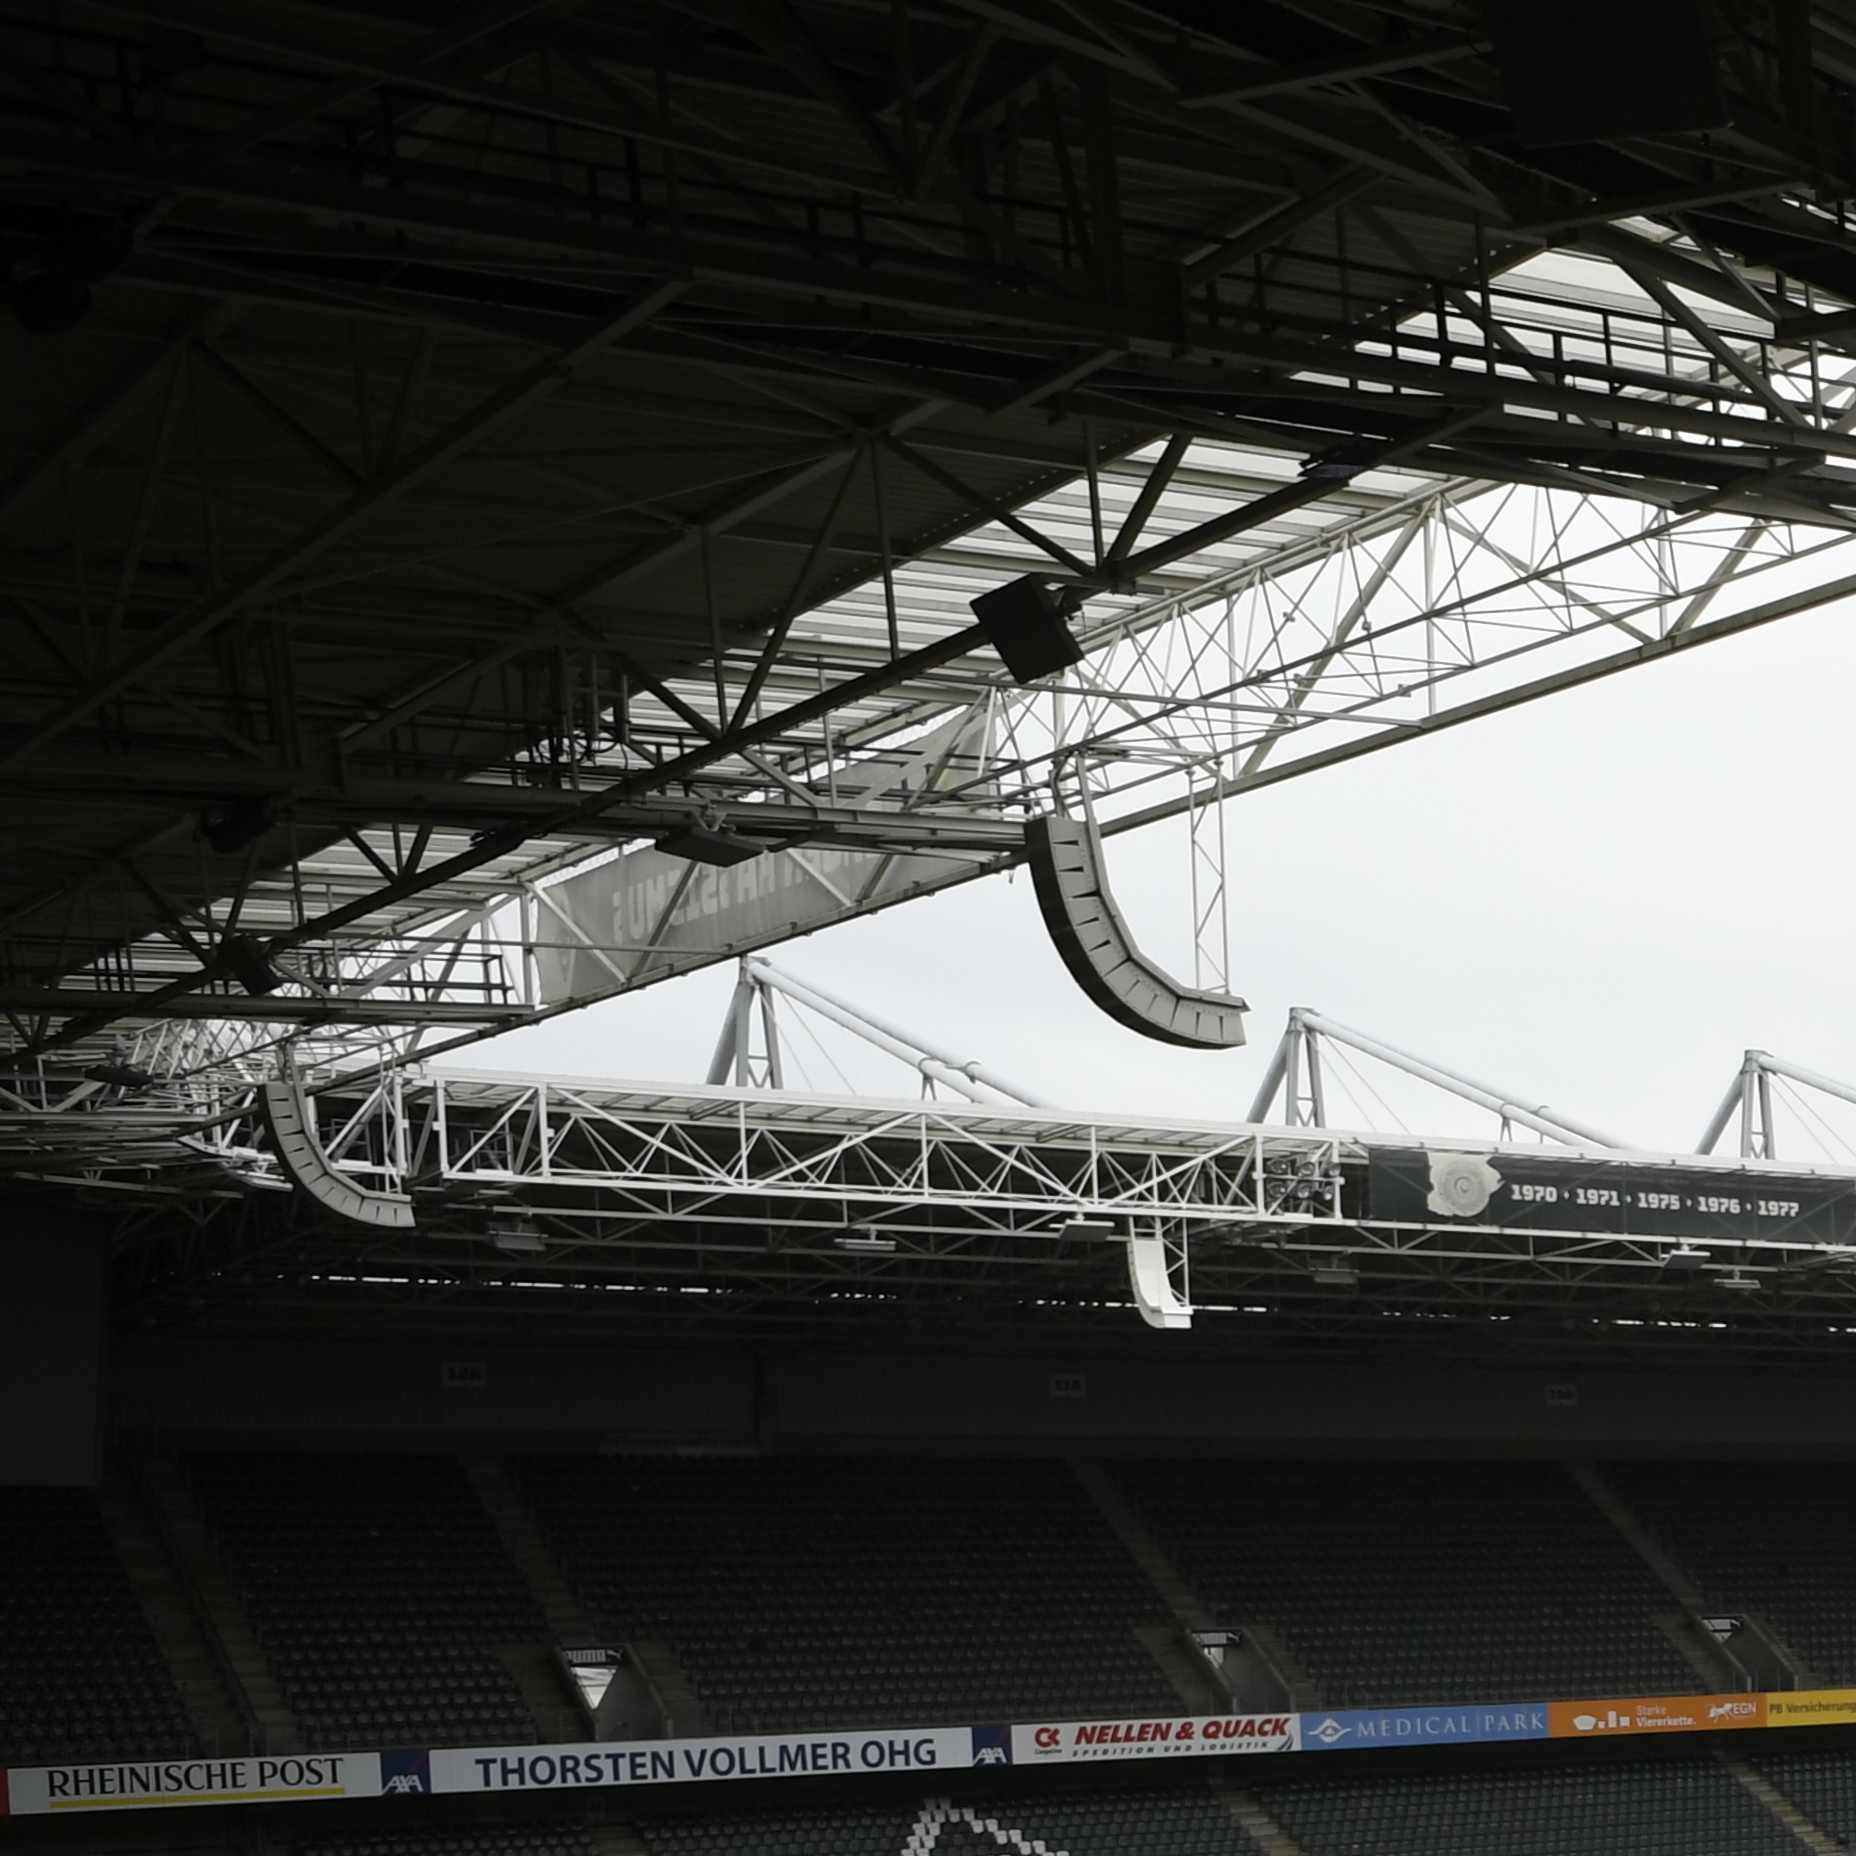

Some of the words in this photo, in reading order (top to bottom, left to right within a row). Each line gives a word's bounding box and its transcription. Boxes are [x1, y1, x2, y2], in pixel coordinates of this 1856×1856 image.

[1511, 1184, 1558, 1203] 1970
[1575, 1188, 1621, 1206] 1971
[1637, 1192, 1681, 1211] 1975
[1697, 1196, 1741, 1215] 1976
[1758, 1199, 1800, 1217] 1977
[1733, 1702, 1758, 1716] EGN
[1768, 1703, 1785, 1715] PB
[1075, 1724, 1172, 1746] NELLEN
[1176, 1721, 1196, 1740] &
[1201, 1718, 1292, 1739] QUACK
[1357, 1717, 1471, 1740] MEDICAL
[1483, 1712, 1546, 1735] PARK
[476, 1754, 676, 1788] THORSTEN
[683, 1745, 854, 1779] VOLLMER
[861, 1739, 937, 1769] OHG
[973, 1747, 1009, 1765] AXA
[48, 1763, 246, 1798] RHEINISCHE
[258, 1757, 344, 1788] POST
[384, 1775, 424, 1793] AXA
